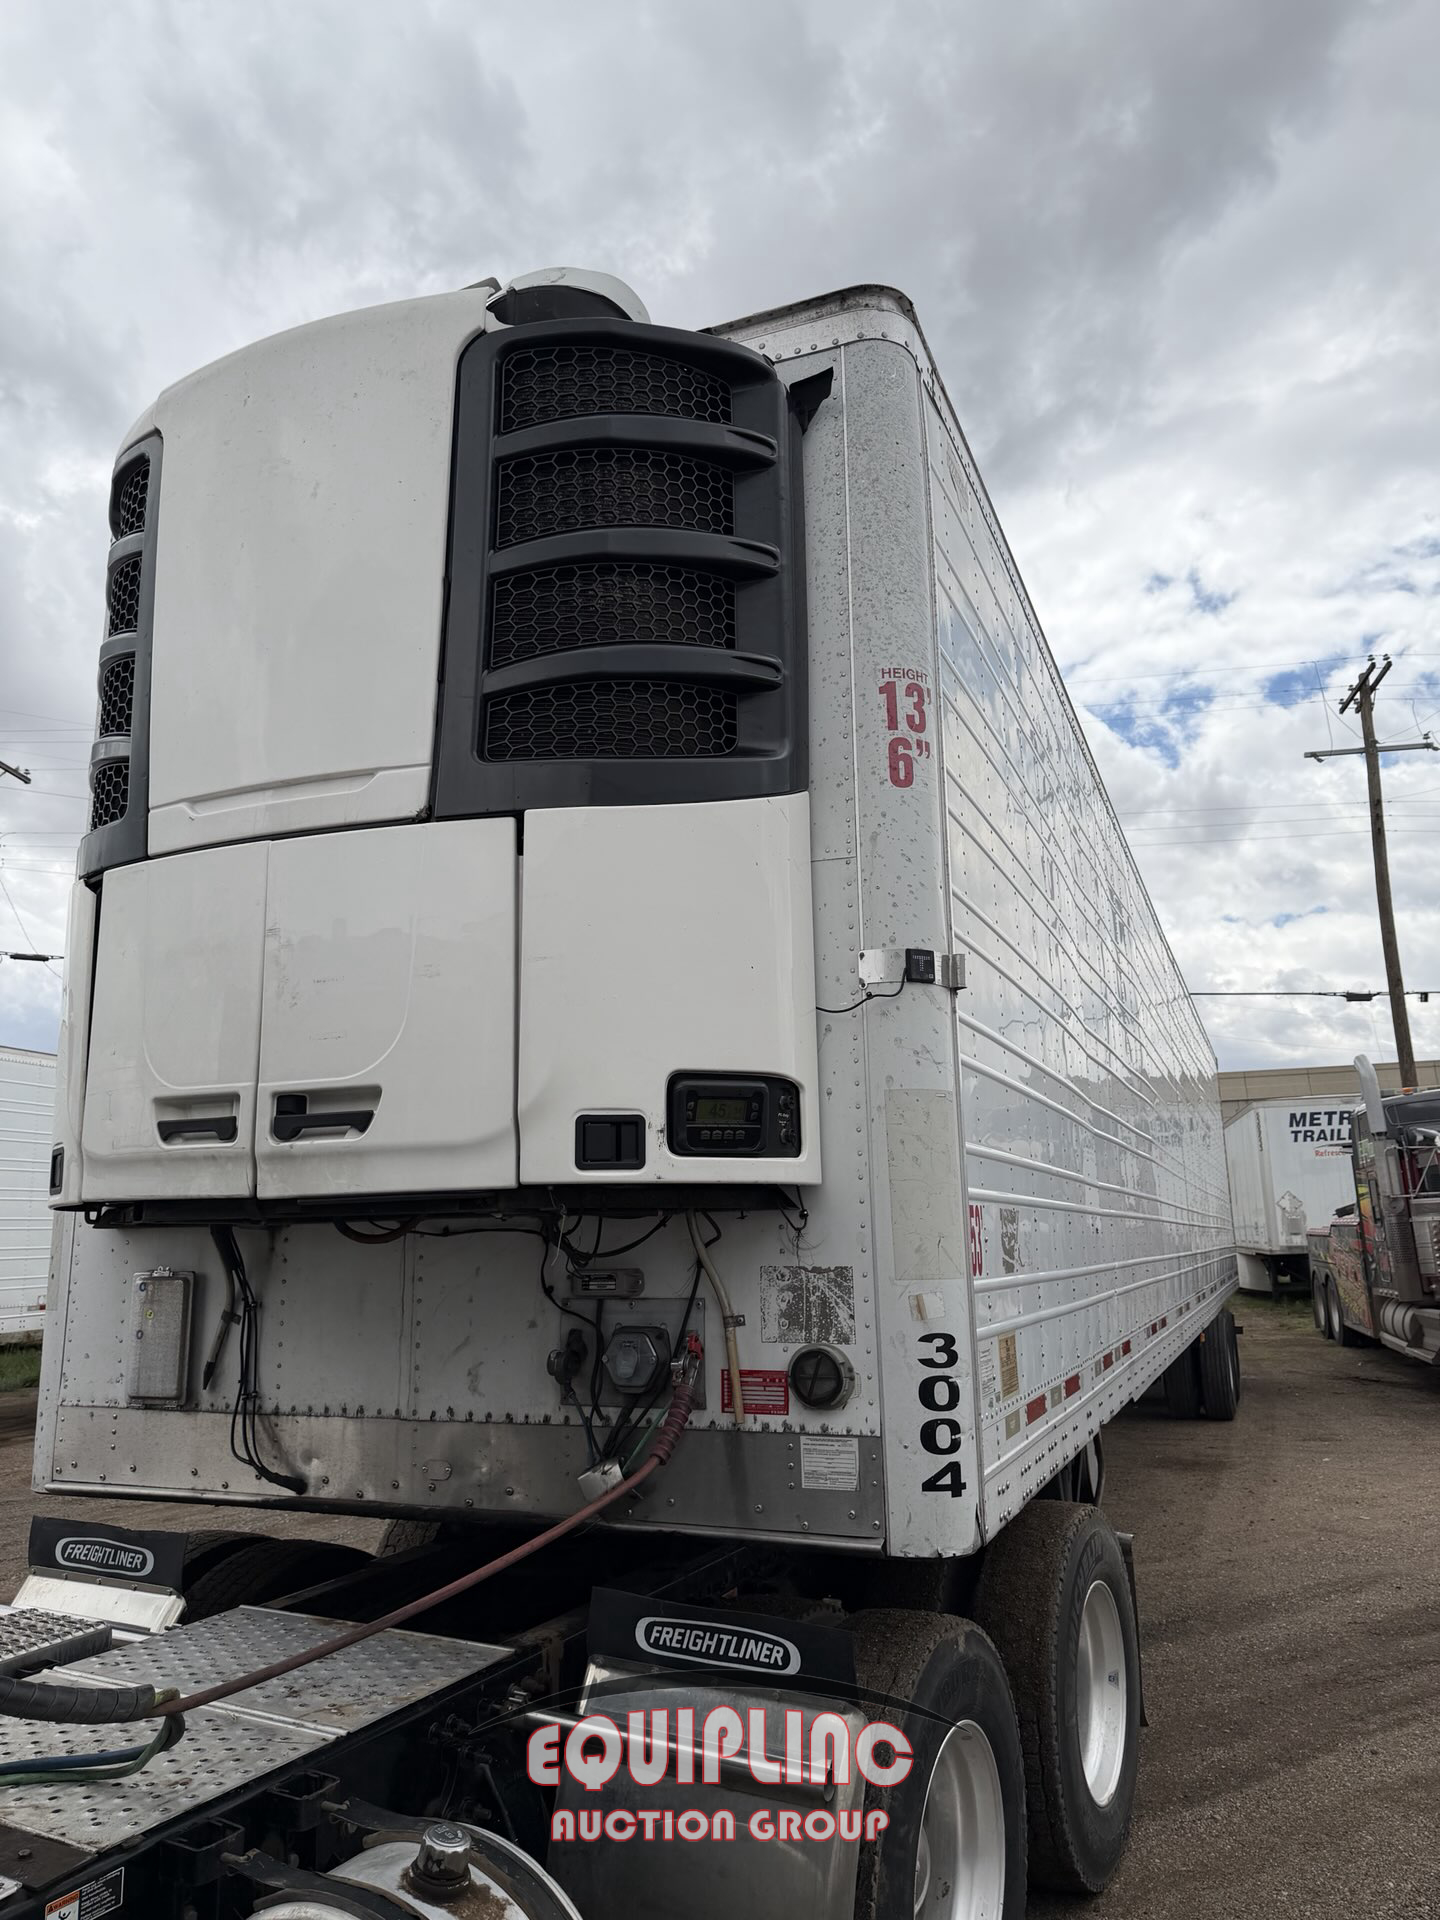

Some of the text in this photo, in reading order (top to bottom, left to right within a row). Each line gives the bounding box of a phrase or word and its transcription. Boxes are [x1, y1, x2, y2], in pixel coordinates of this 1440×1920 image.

[881, 667, 928, 685] HEIGHT
[1289, 1110, 1352, 1128] METR
[1291, 1128, 1352, 1143] TRAIL
[917, 1332, 967, 1498] 3004
[64, 1543, 143, 1569] FREIGHTLINER
[649, 1625, 785, 1666] FREIGHTLINER
